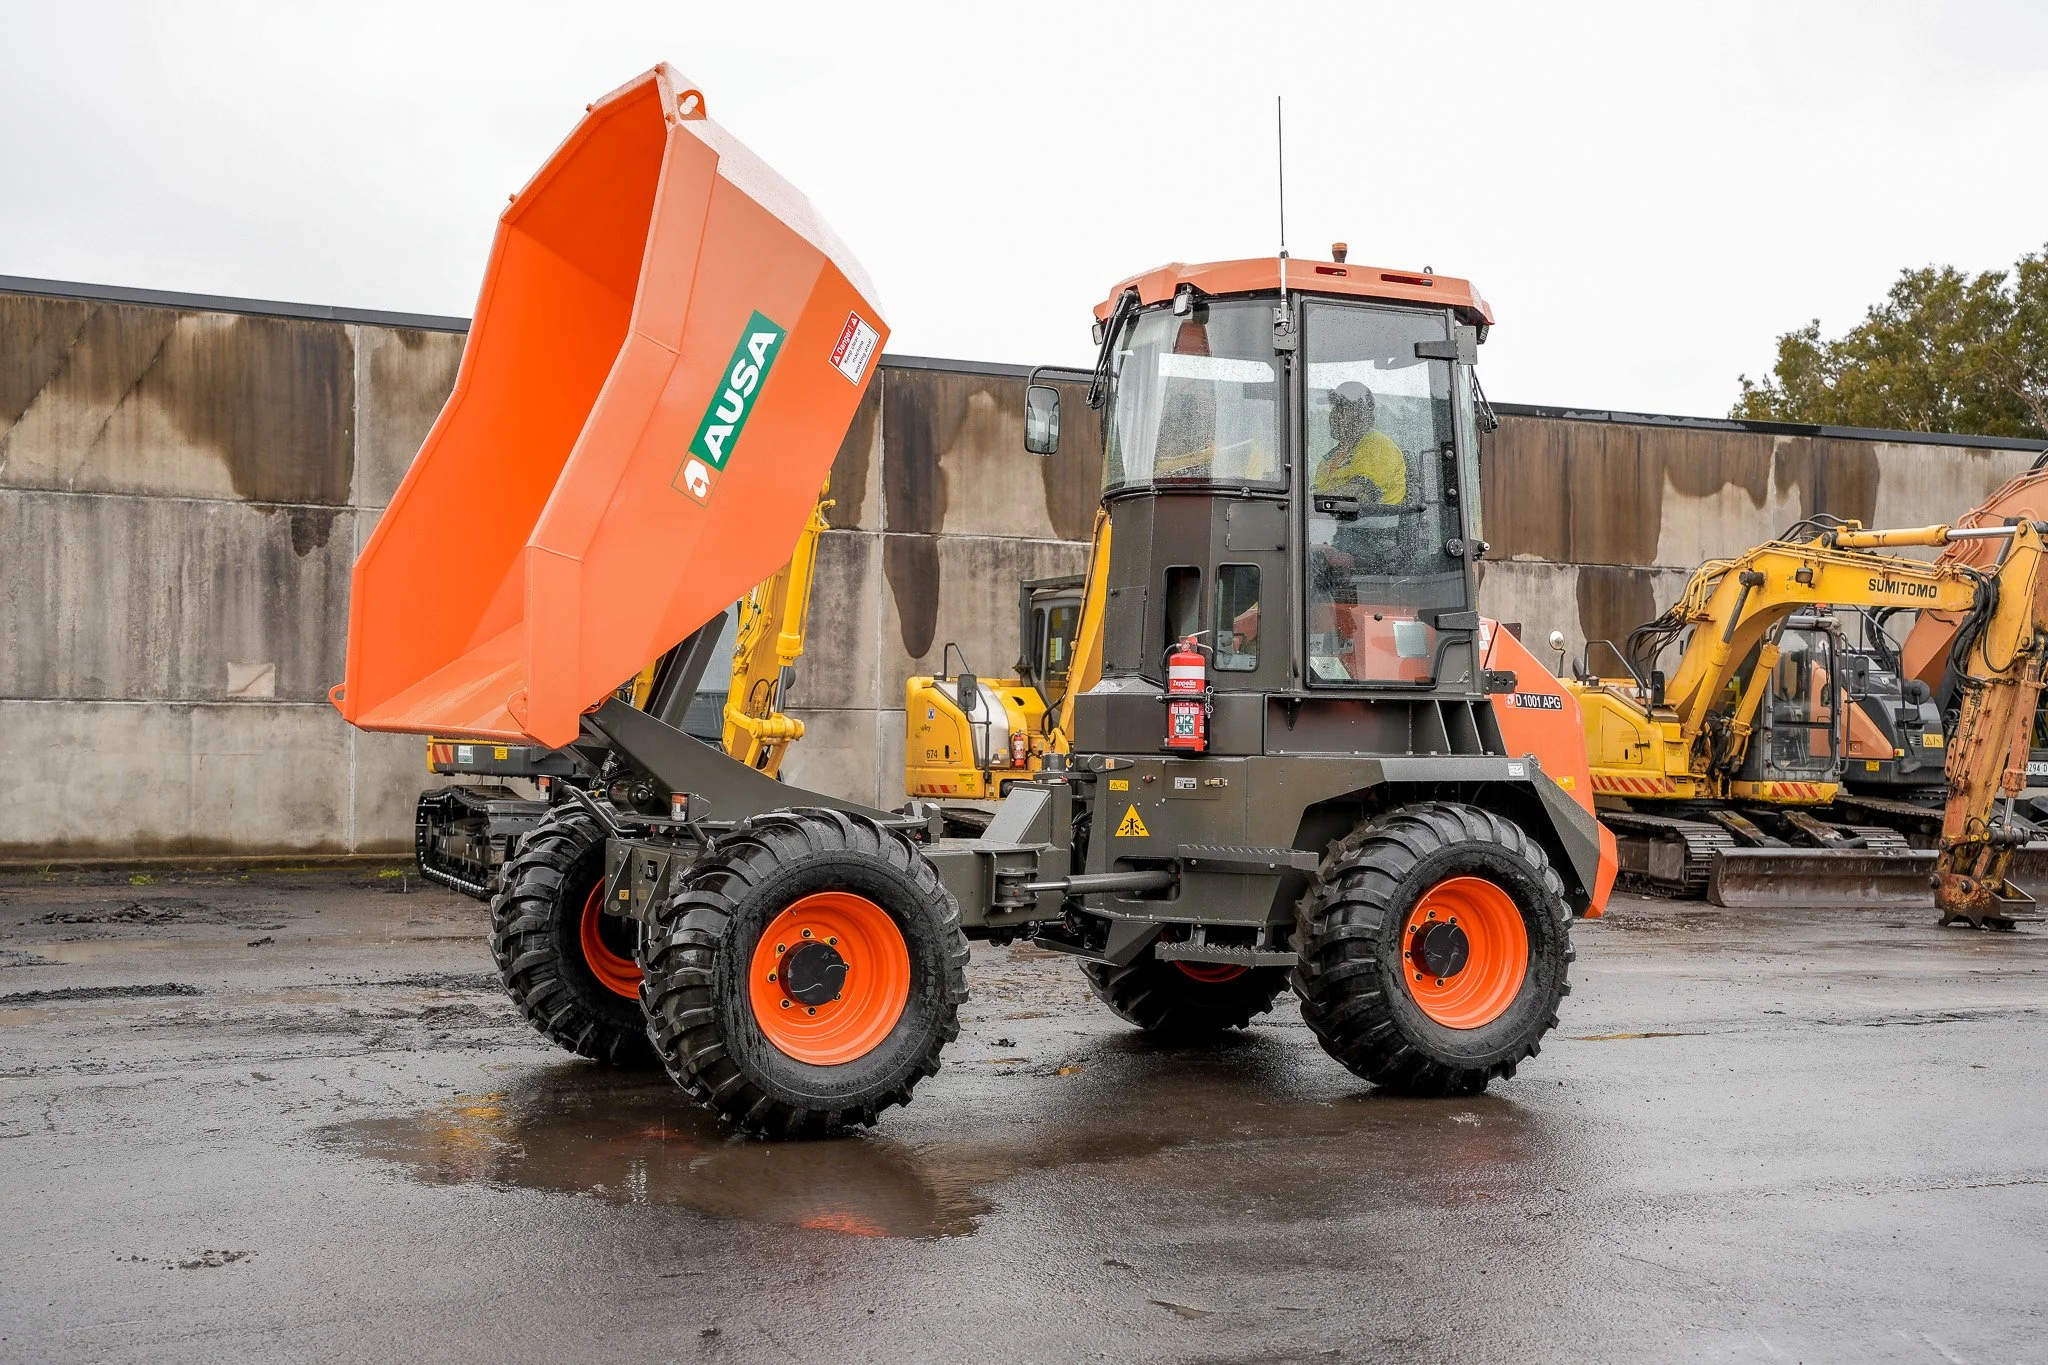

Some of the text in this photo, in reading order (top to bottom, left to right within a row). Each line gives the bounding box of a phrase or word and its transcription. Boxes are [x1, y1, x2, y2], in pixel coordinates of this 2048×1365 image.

[843, 348, 853, 364] Keep
[849, 335, 858, 349] clear
[851, 340, 864, 363] machine
[854, 352, 866, 374] working
[704, 333, 777, 463] AUSA
[1868, 578, 1938, 599] SUMITOMO
[1515, 694, 1561, 708] D 1001 APG
[926, 749, 938, 759] 674
